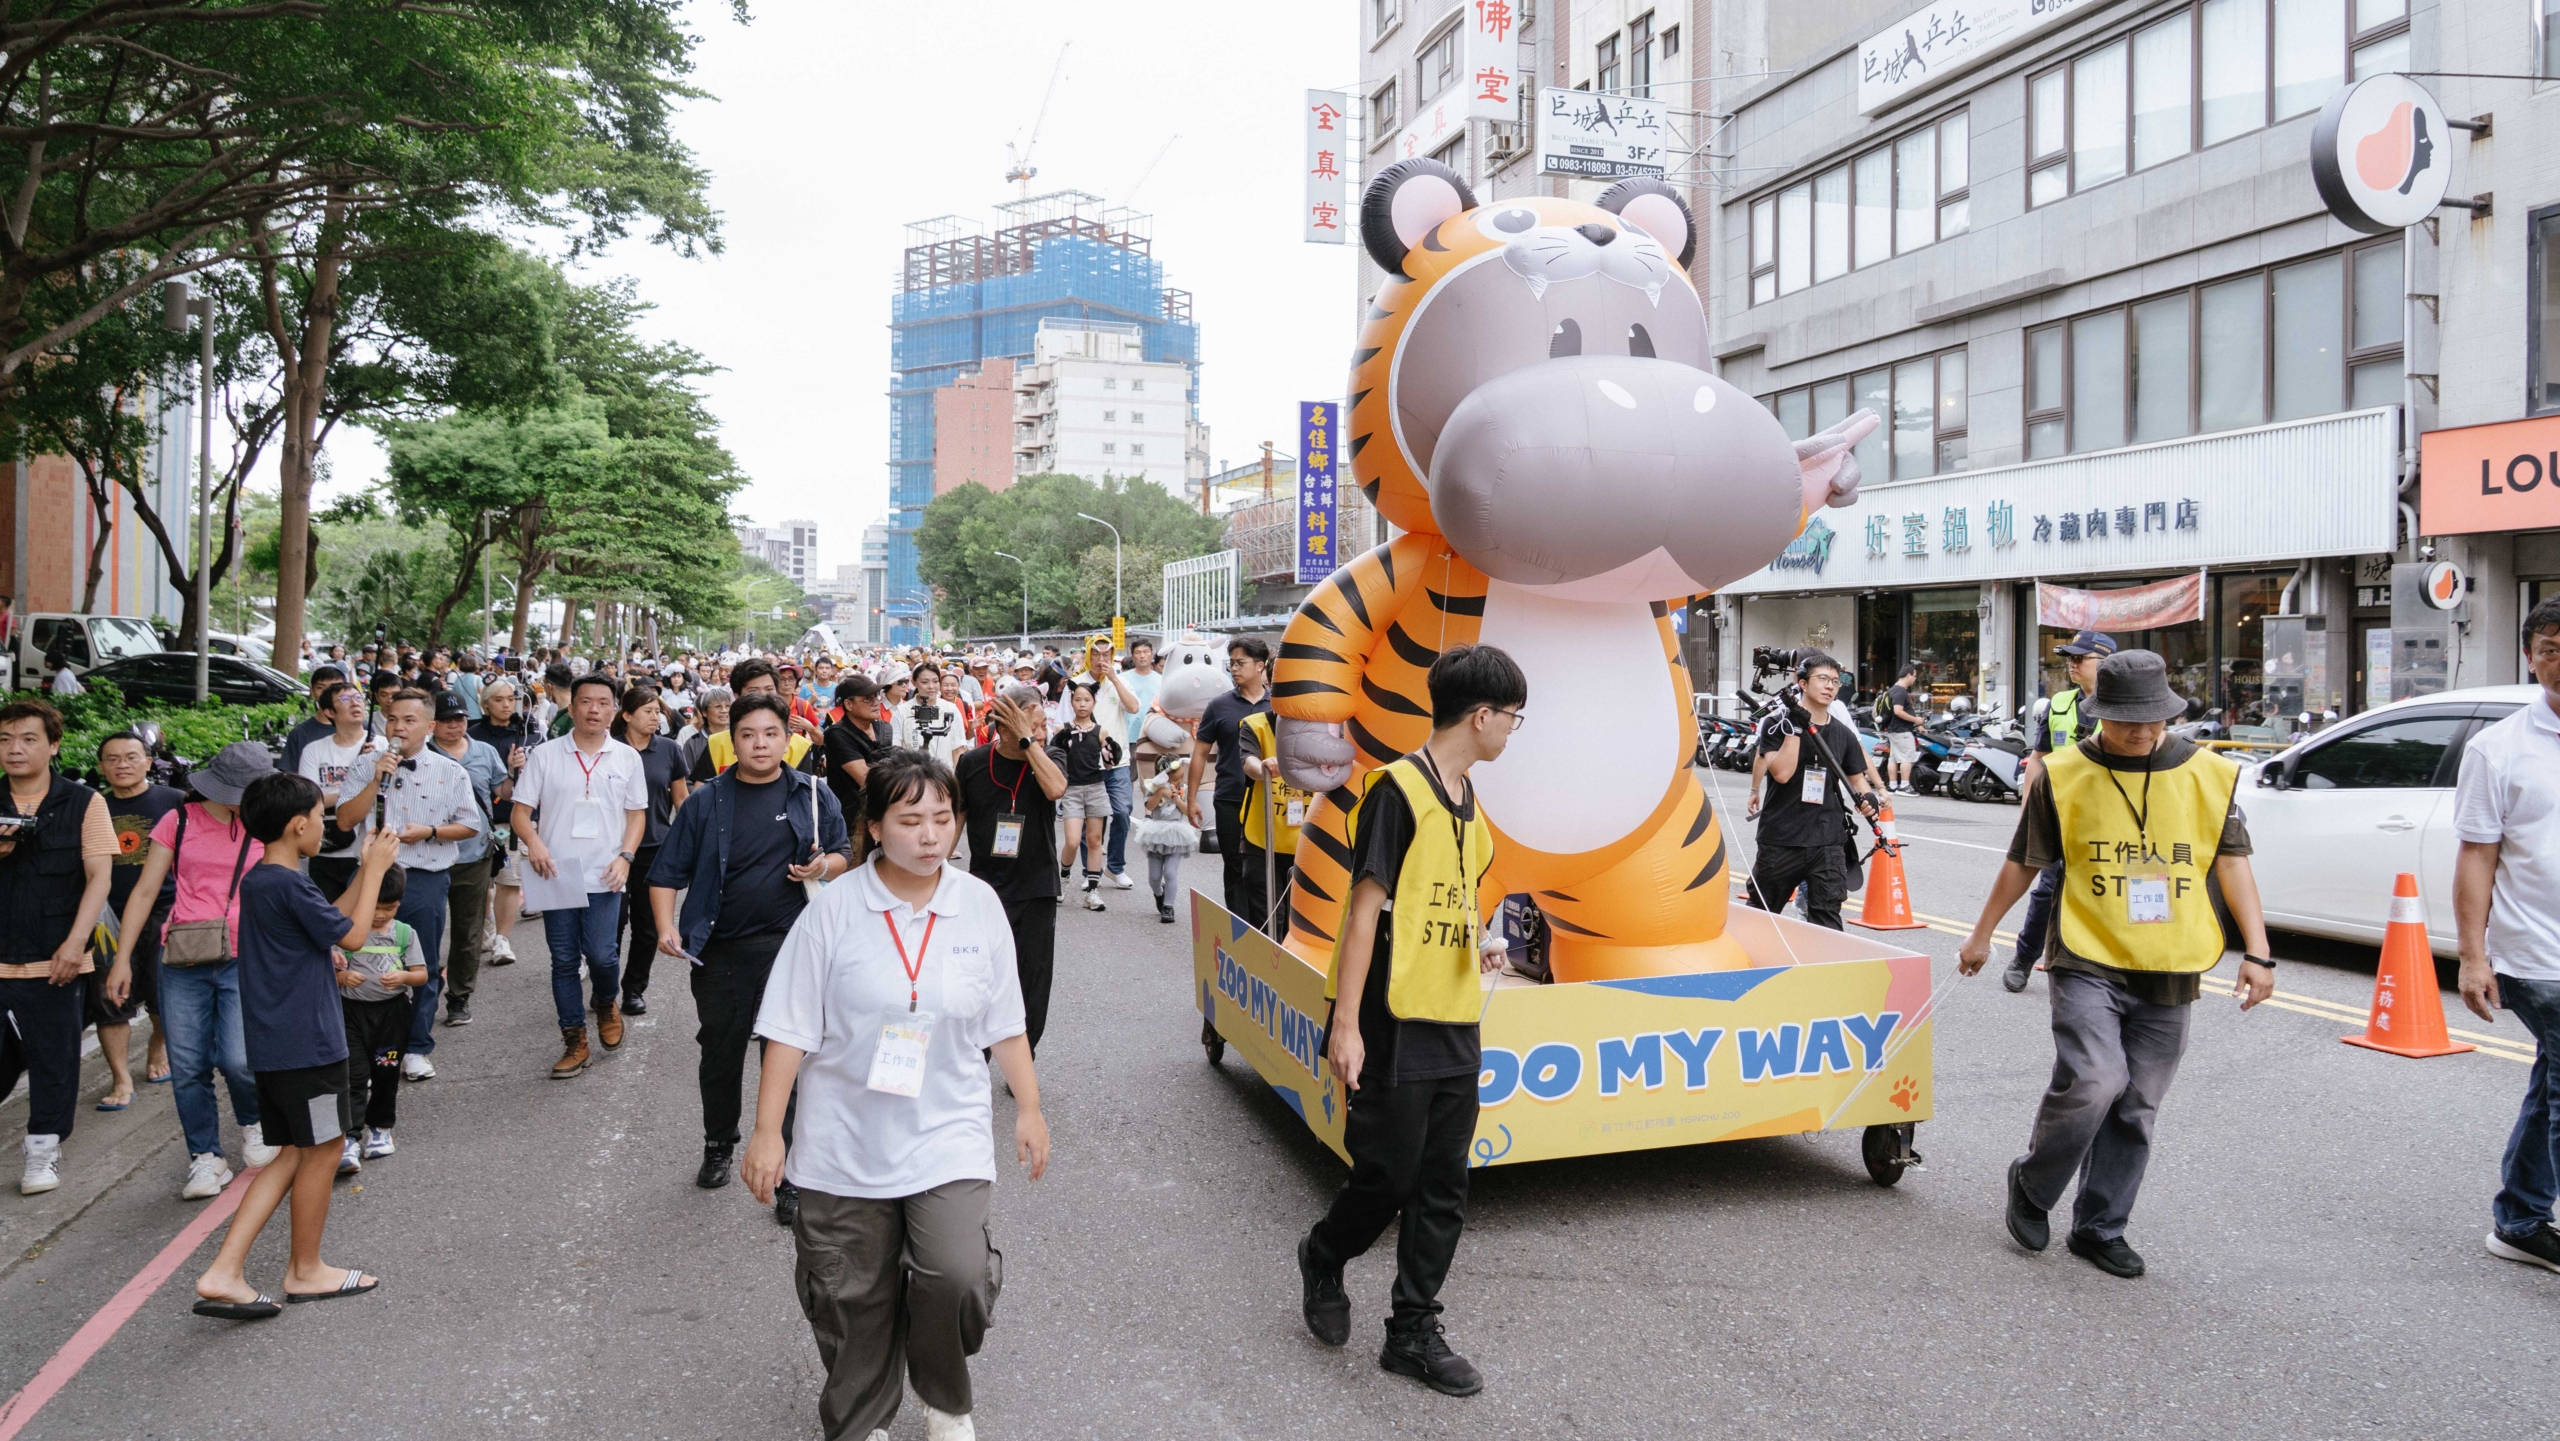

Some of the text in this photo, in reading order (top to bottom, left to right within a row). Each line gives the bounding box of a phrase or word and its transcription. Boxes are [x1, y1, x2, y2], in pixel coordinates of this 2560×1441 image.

[1475, 0, 1512, 103] 佛堂
[1590, 148, 1604, 156] 2013
[1627, 146, 1646, 160] 3F
[1311, 103, 1341, 229] 全真堂
[1560, 159, 1611, 174] 0983-118093
[1865, 497, 2199, 558] 好室鍋物 冷藏肉專門店
[2088, 841, 2193, 866] 工作人員
[2091, 874, 2192, 898] STF
[1217, 946, 1248, 1011] ZOO
[1249, 973, 1277, 1040] MY
[1280, 998, 1324, 1081] WAY
[879, 1052, 916, 1069] 工作證
[1479, 1011, 1901, 1105] OO MY WAY
[1680, 1113, 1719, 1124] HSINCHU
[1722, 1110, 1741, 1120] ZOO
